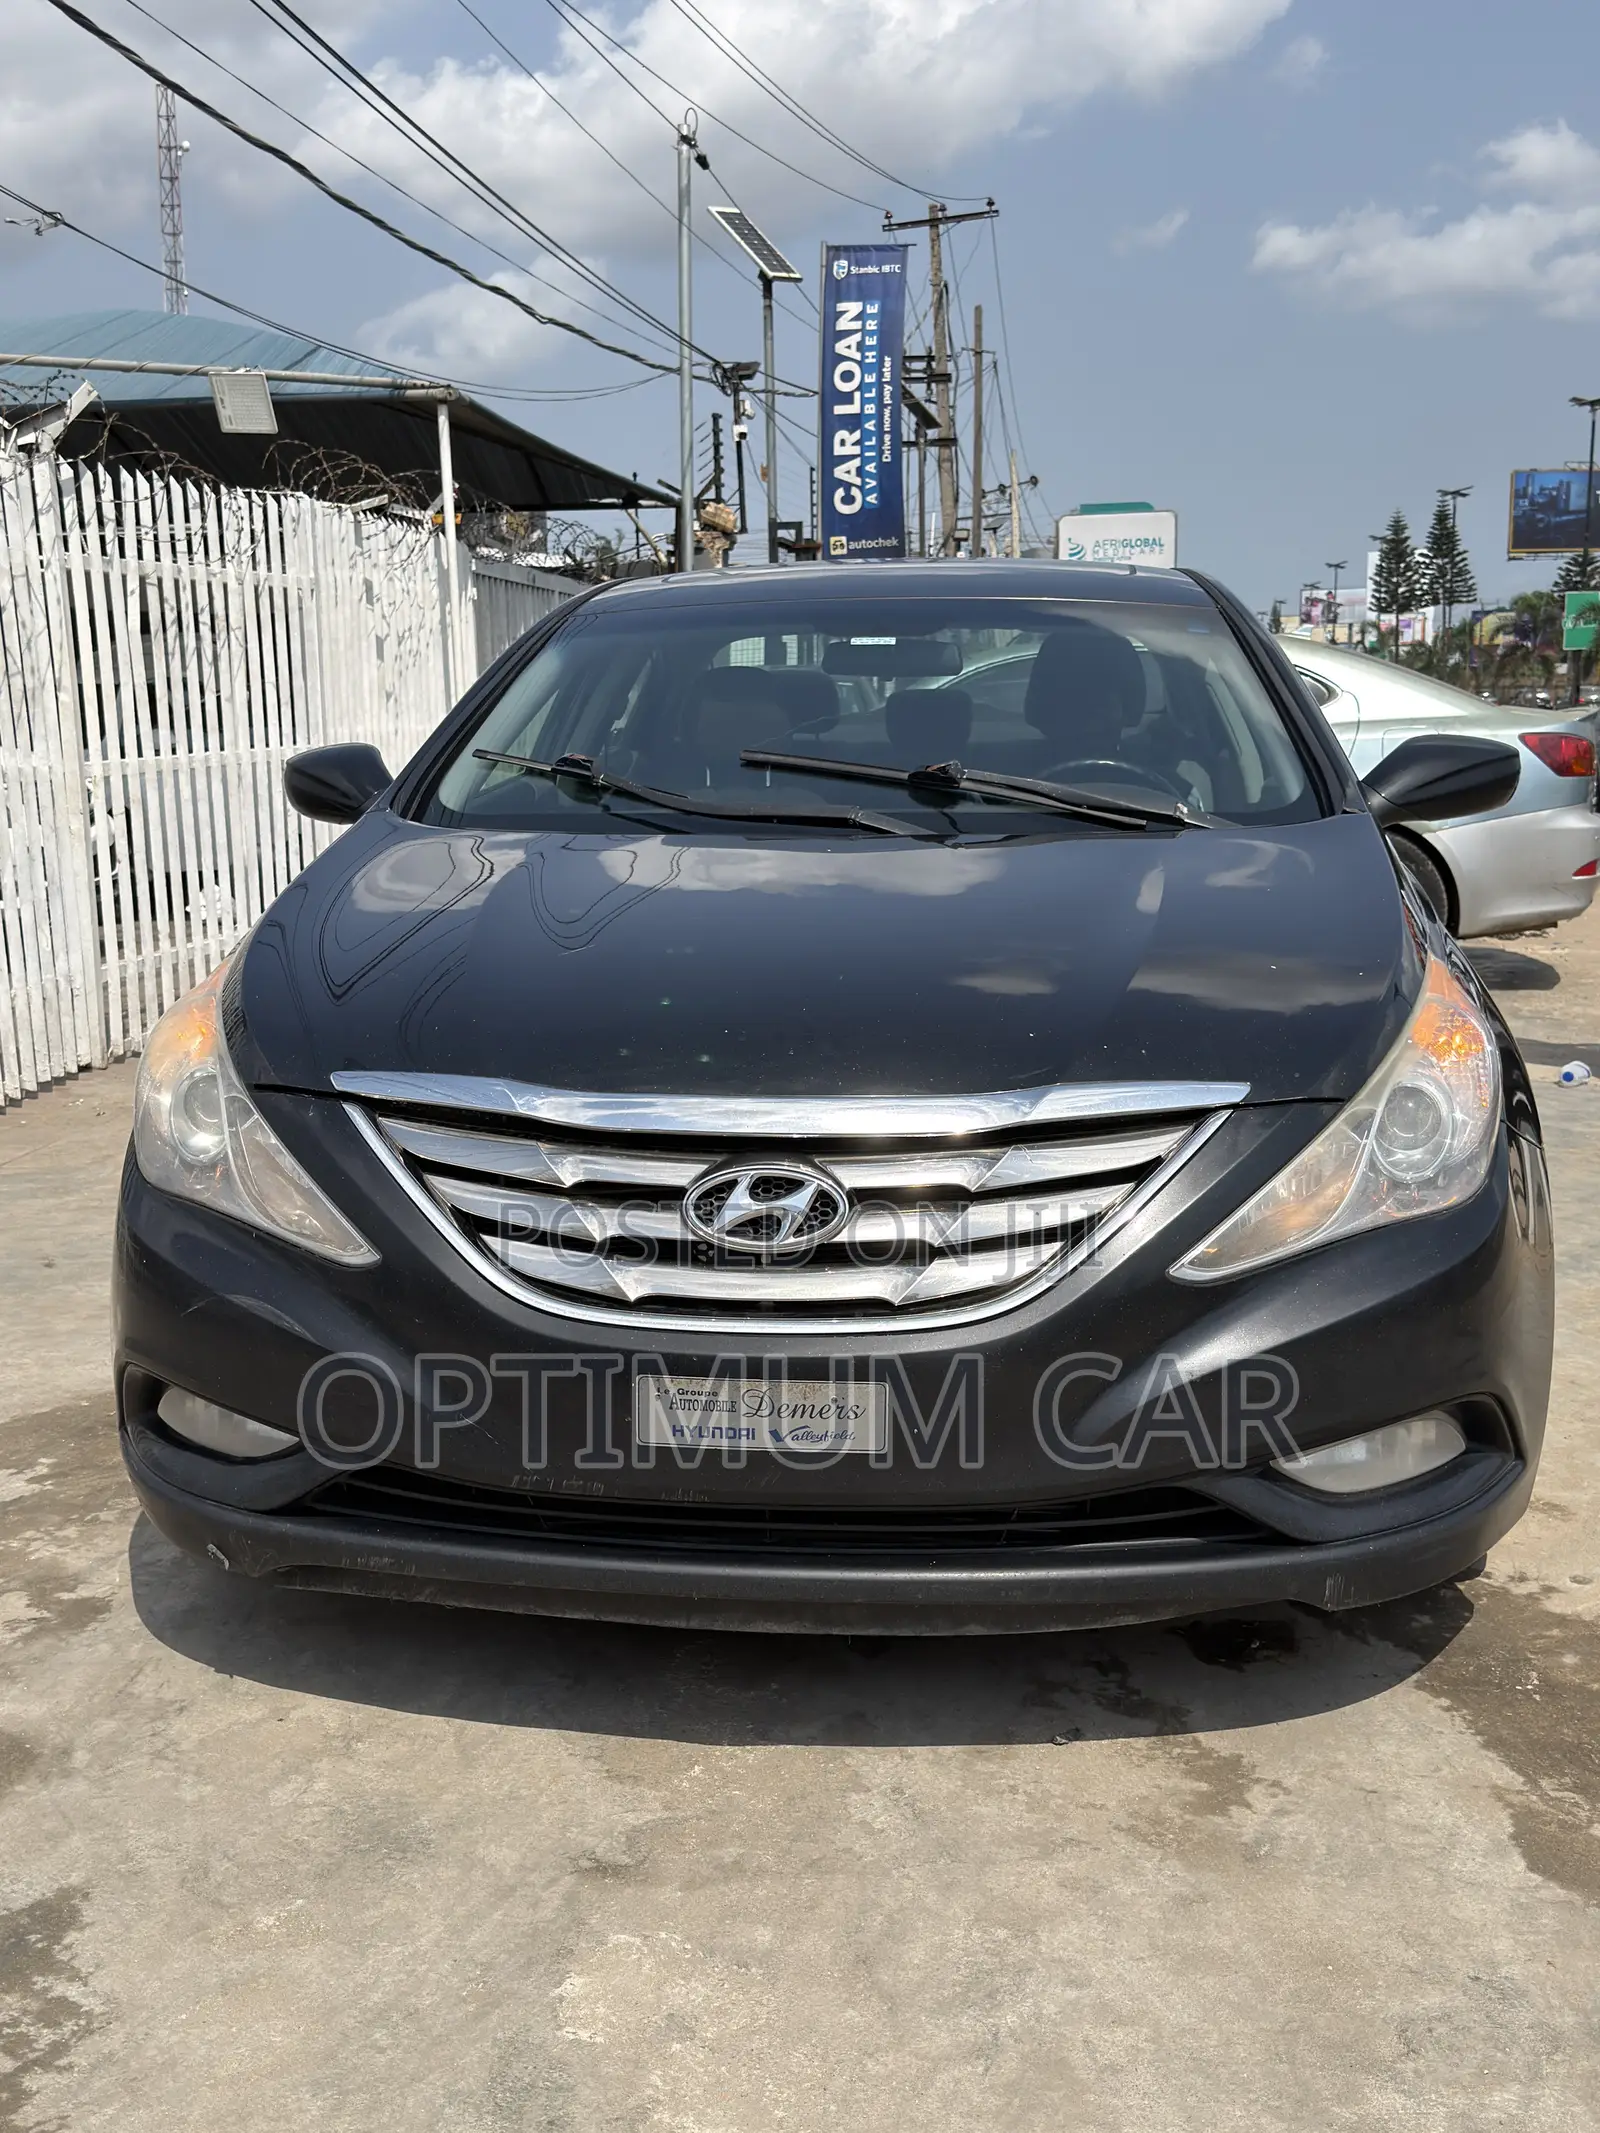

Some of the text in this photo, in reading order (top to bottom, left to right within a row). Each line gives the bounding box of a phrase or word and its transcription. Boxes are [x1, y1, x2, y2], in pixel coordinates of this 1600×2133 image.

[850, 264, 901, 274] Stanbic IBTC
[881, 355, 891, 382] later
[864, 303, 879, 504] AVAILABLE HERE
[882, 384, 893, 404] pay
[833, 301, 863, 515] CAR LOAN
[882, 433, 891, 463] Drive
[848, 536, 899, 550] autochek
[657, 1387, 718, 1398] Le Groupe
[668, 1392, 737, 1413] AUTOMOBILE
[672, 1424, 856, 1444] HYUNDAI Valleyfield
